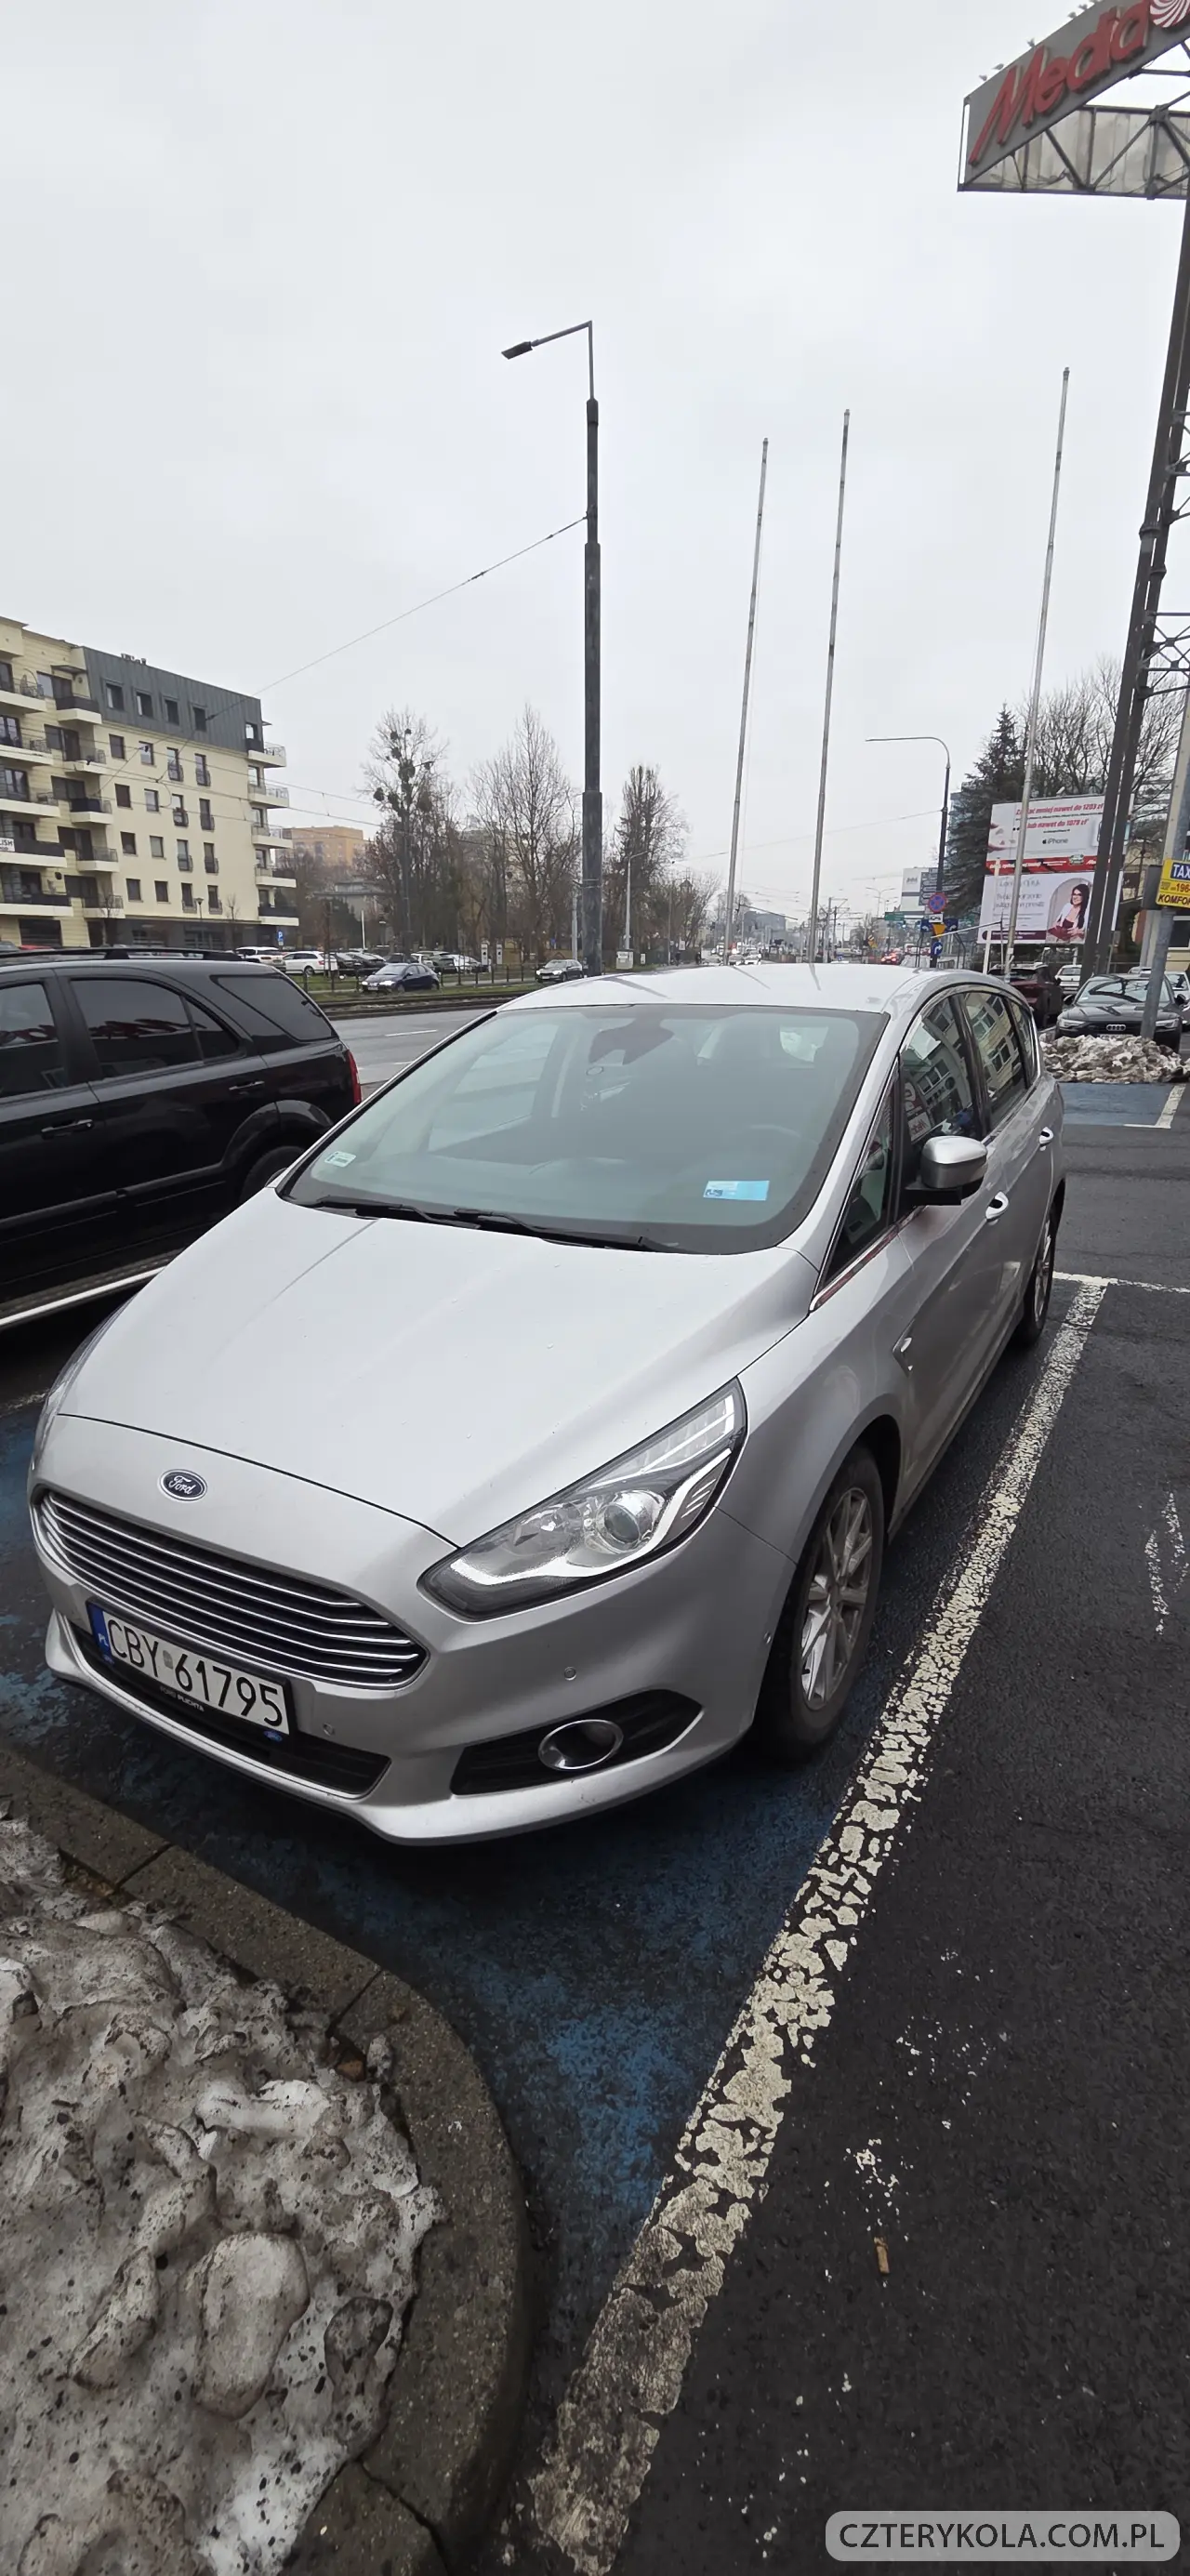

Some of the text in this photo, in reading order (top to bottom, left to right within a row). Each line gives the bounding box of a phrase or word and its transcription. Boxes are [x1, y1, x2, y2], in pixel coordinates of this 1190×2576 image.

[968, 0, 1151, 165] Media
[168, 1475, 196, 1495] Ford
[98, 1633, 110, 1646] PL
[107, 1619, 283, 1727] CBY 61795
